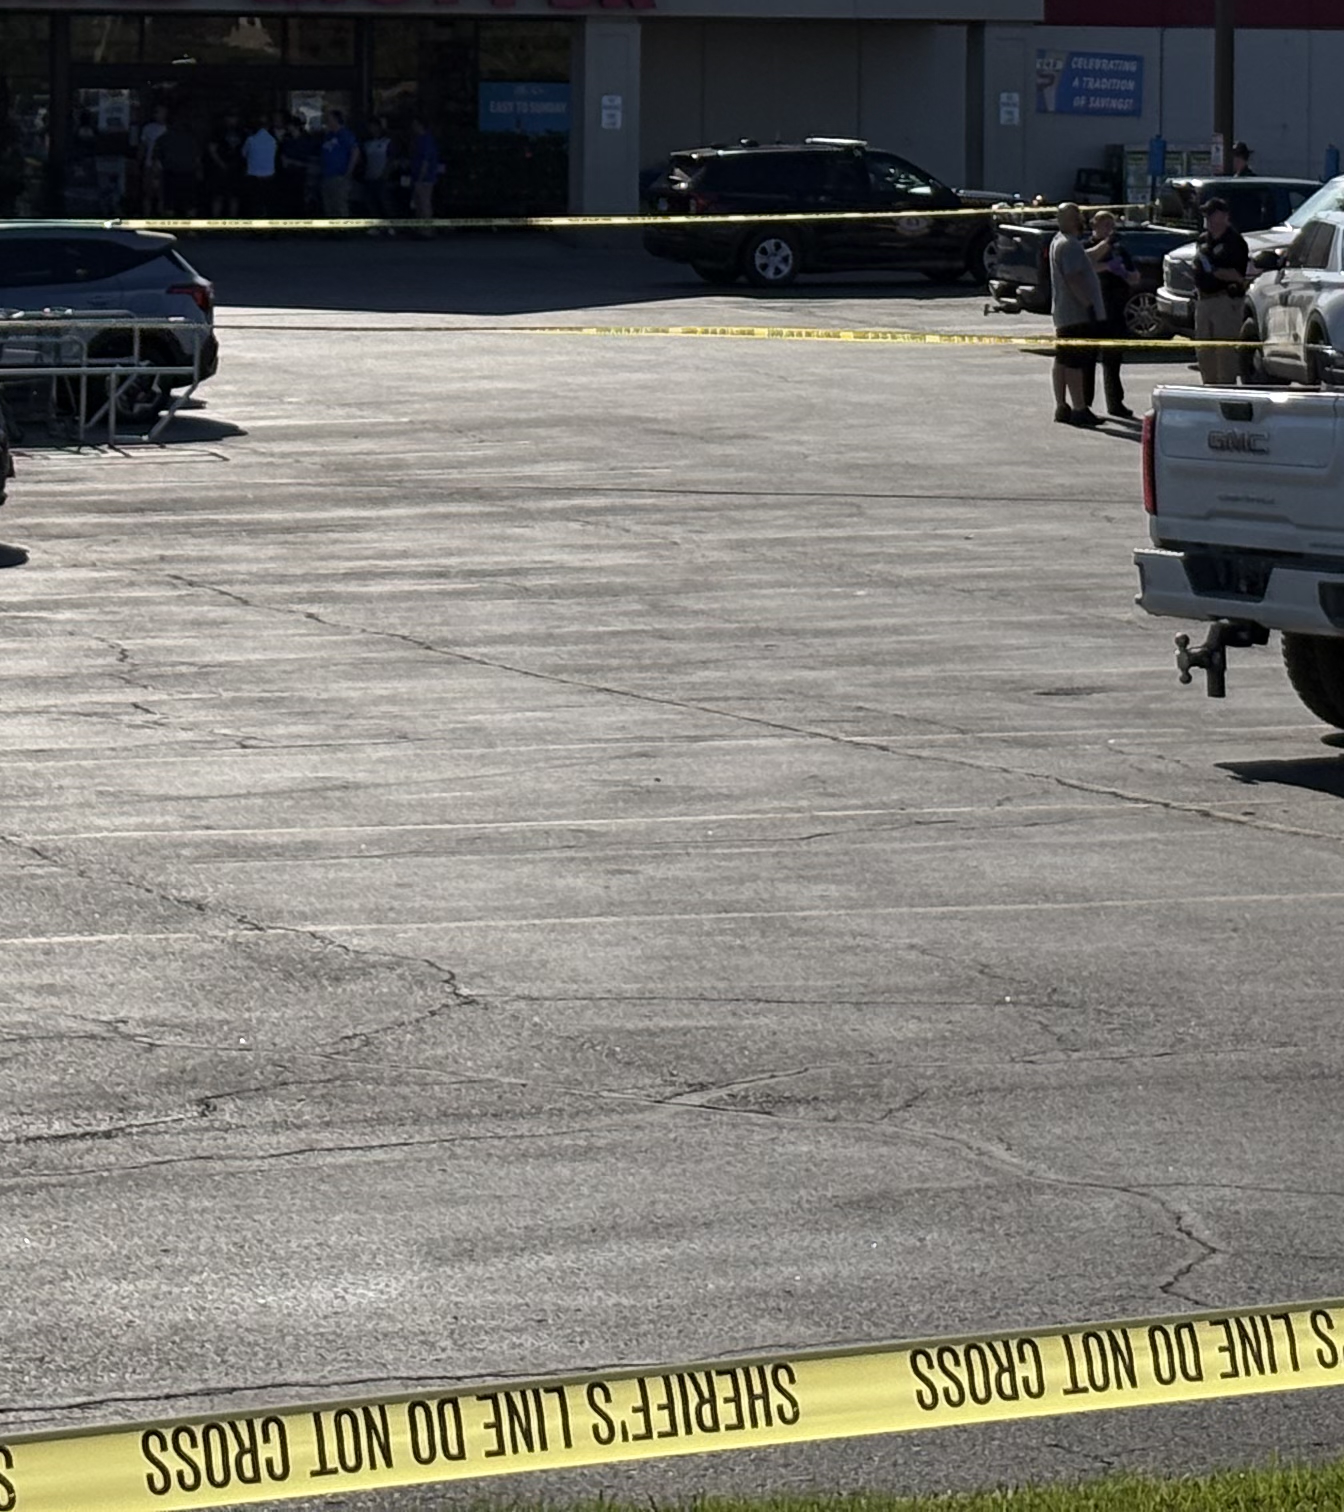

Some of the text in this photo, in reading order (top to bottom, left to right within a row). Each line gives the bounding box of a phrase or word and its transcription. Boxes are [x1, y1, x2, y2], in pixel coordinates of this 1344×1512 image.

[1071, 56, 1138, 73] CELEBRATING
[1072, 76, 1135, 91] A TRADITION
[1072, 95, 1086, 108] OF
[1207, 430, 1270, 456] GMC
[910, 1341, 1044, 1410] CROSS
[1063, 1331, 1136, 1394] NOT
[1149, 1324, 1203, 1385] DO
[1210, 1315, 1298, 1378] LINE
[142, 1366, 799, 1495] SHERIFF'S LINE DO NOT CROSS
